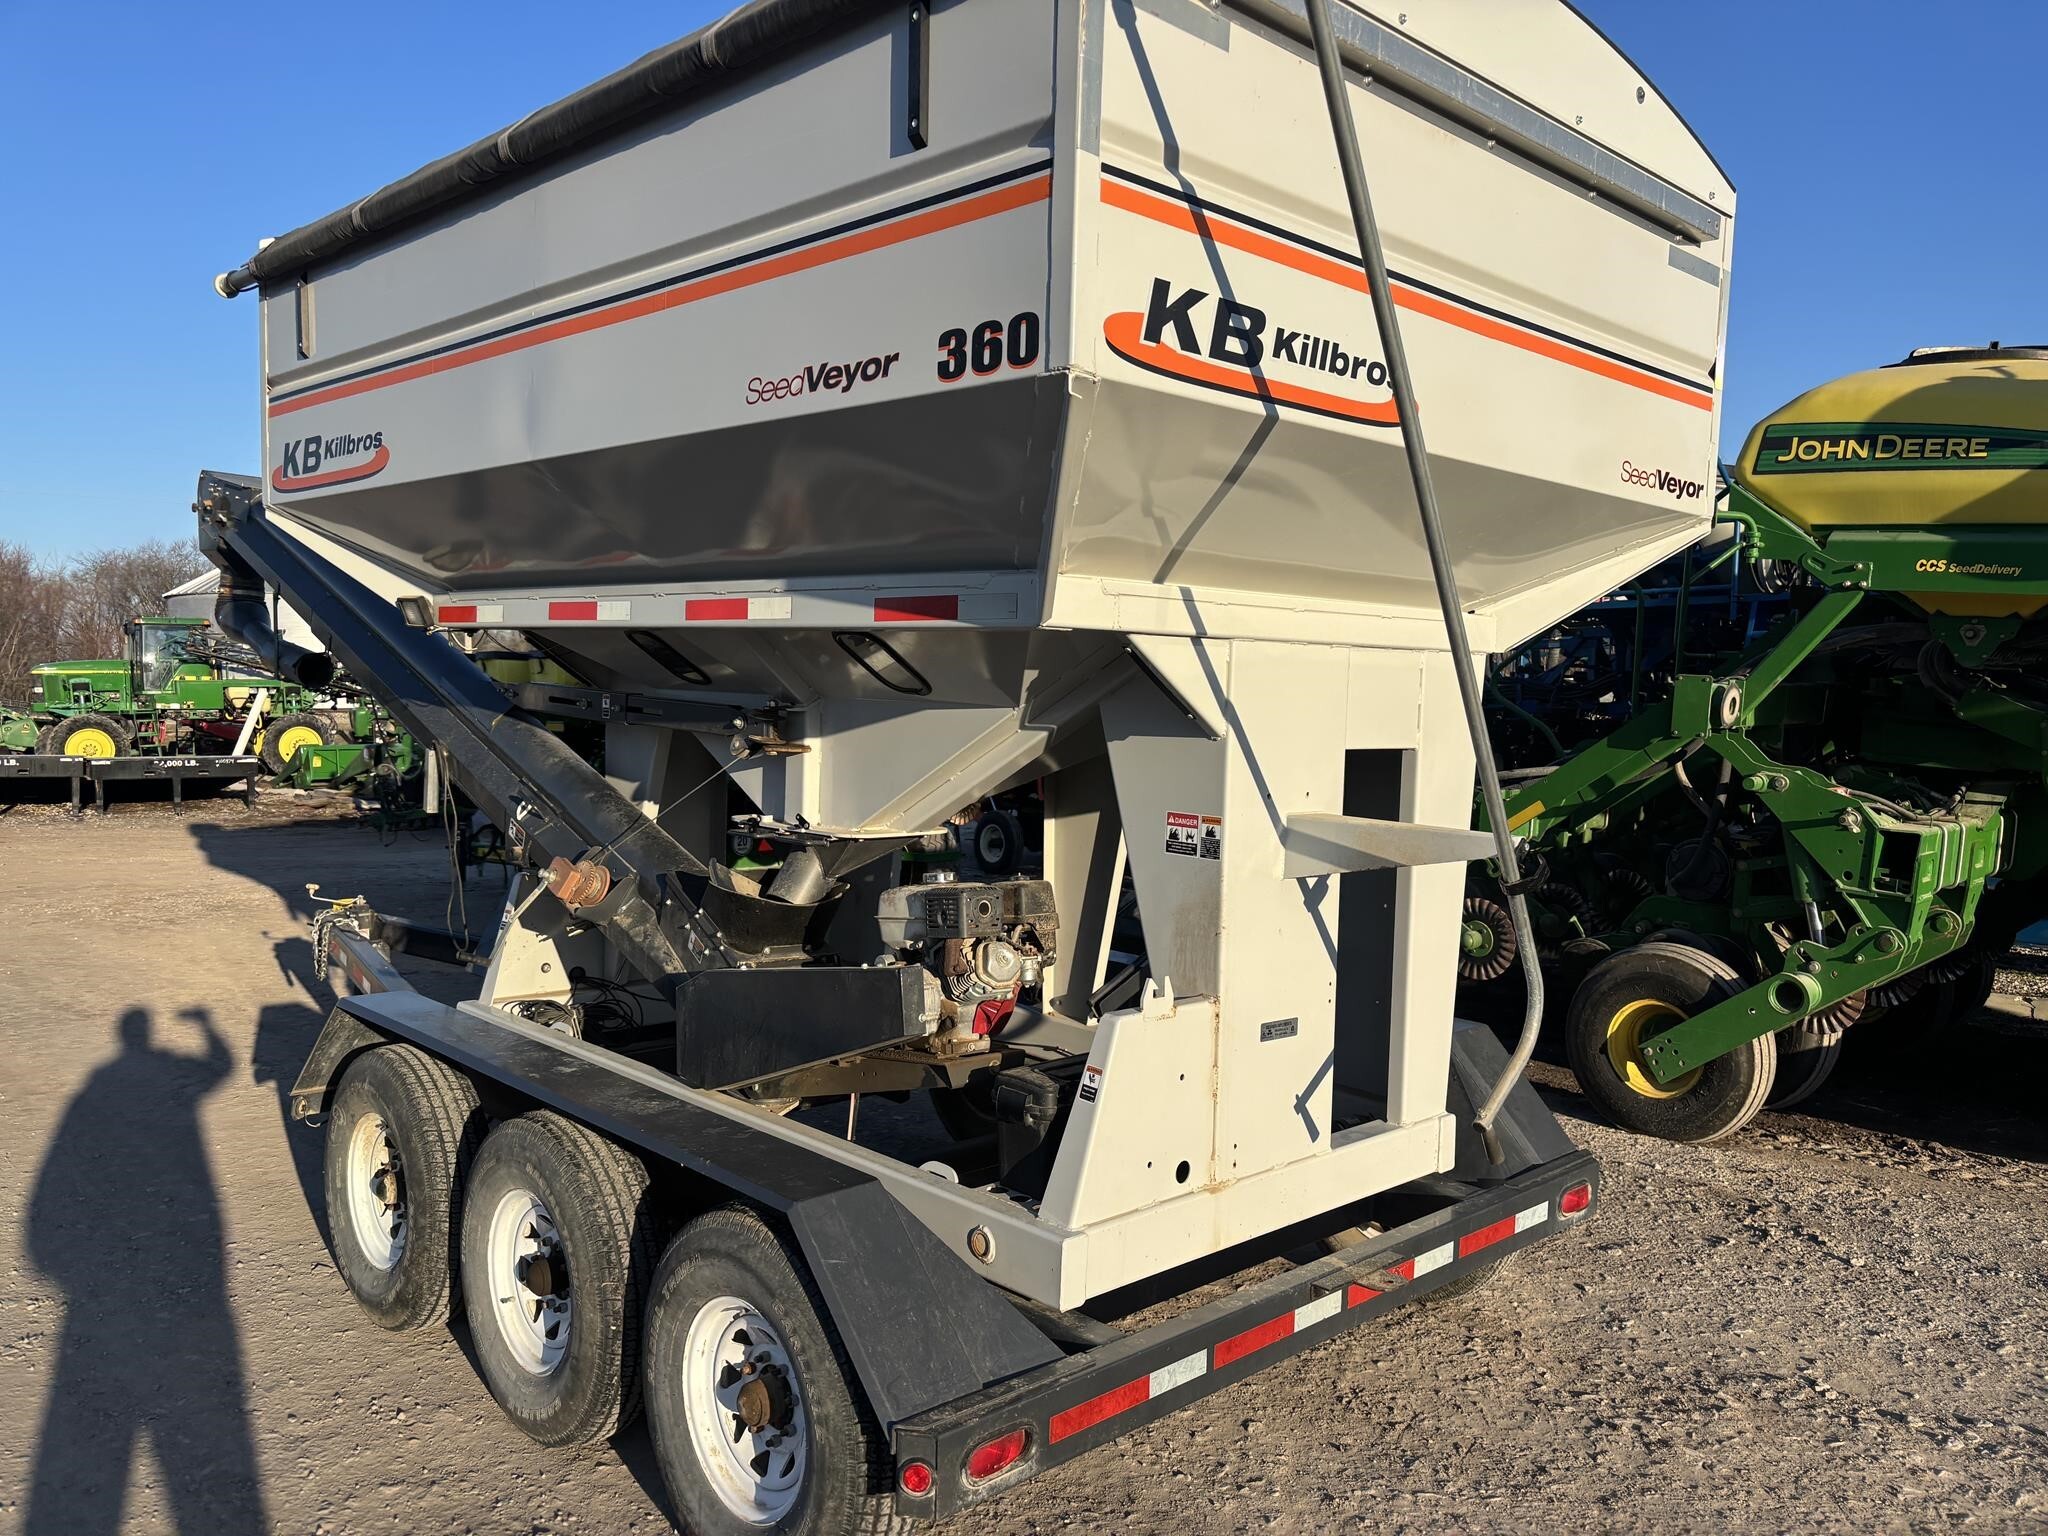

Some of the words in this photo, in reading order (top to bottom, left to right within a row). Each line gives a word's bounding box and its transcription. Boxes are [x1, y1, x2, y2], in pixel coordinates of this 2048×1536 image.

[1143, 277, 1267, 369] KB
[937, 311, 1040, 383] 360
[746, 352, 900, 405] SeedVeyor
[282, 435, 322, 478] KB
[324, 431, 383, 460] Killbros
[1777, 436, 1870, 462] JOHN
[1874, 434, 1990, 458] DEERE
[1620, 460, 1705, 499] SeedVeyor
[1915, 559, 1948, 572] CCS
[1949, 563, 2022, 577] SeedDelivery
[184, 759, 200, 767] LB.
[1174, 817, 1198, 827] DANGER
